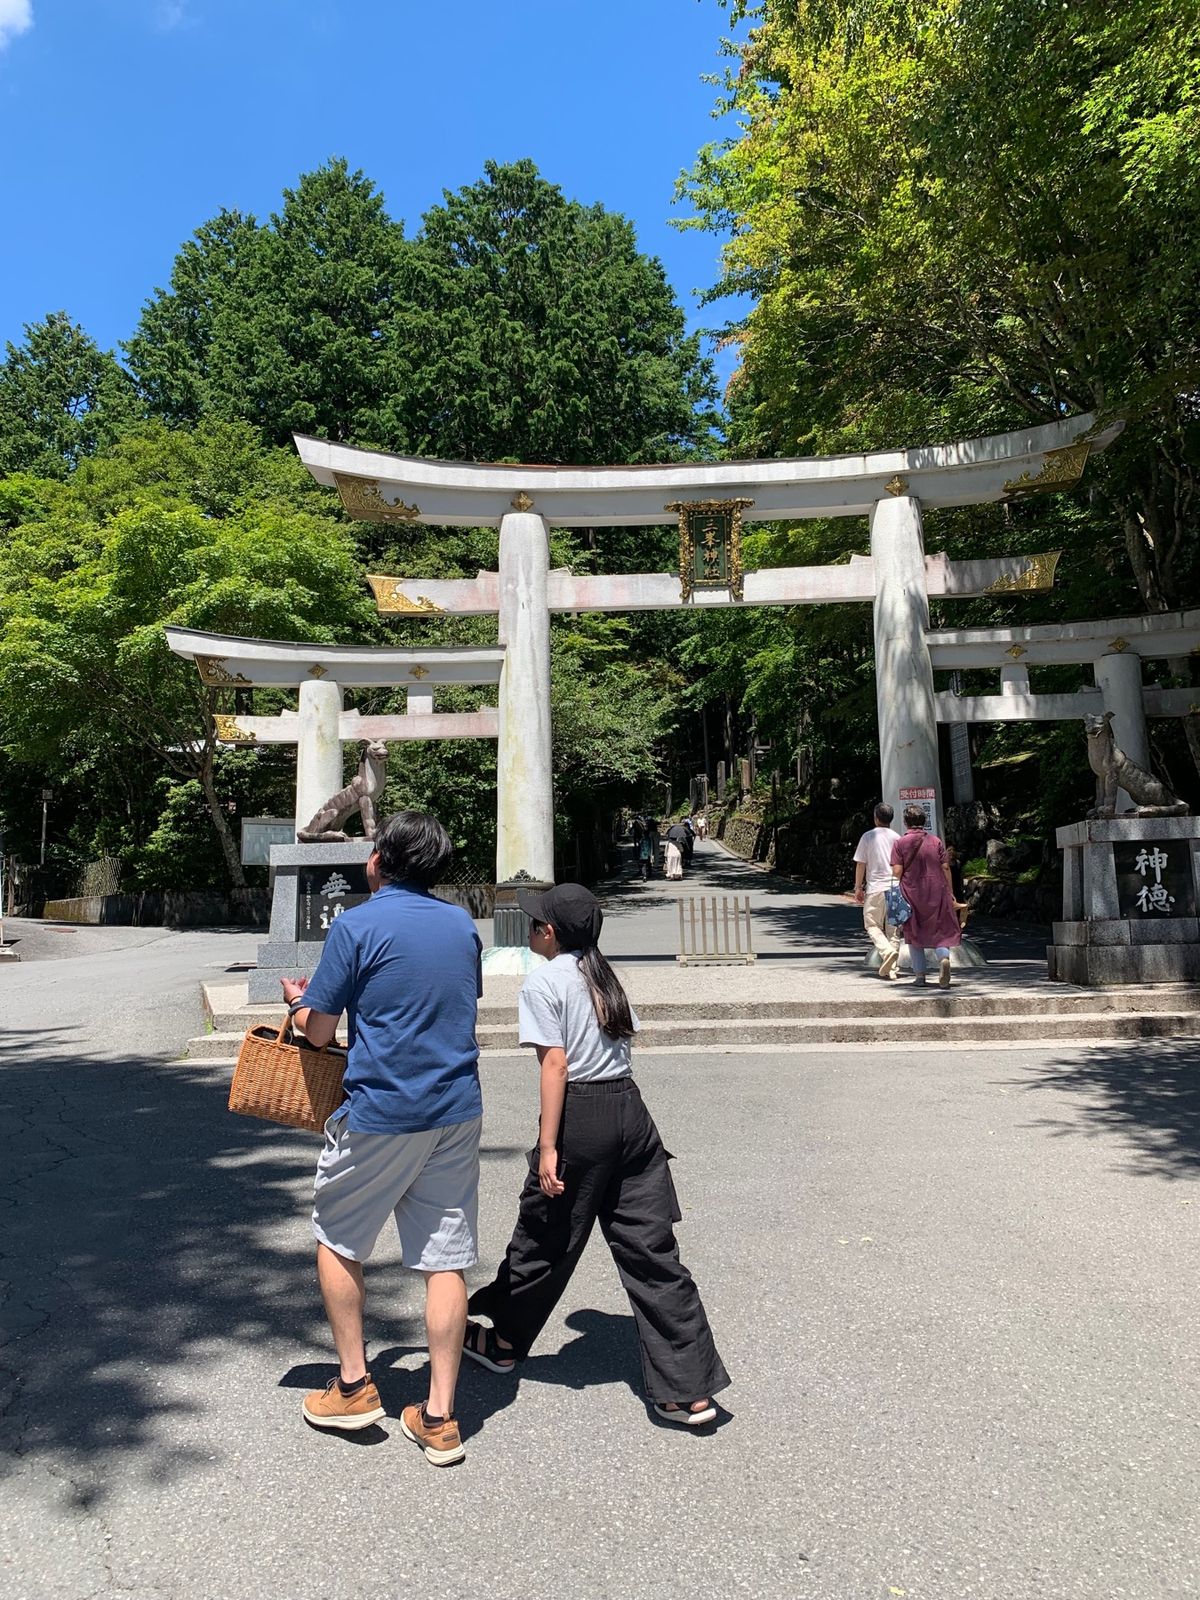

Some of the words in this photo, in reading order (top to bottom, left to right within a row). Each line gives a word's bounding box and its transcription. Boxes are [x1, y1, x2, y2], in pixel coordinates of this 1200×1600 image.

[700, 519, 721, 580] 三峯神社
[900, 789, 935, 799] 受付時間
[1134, 847, 1176, 913] 神徳
